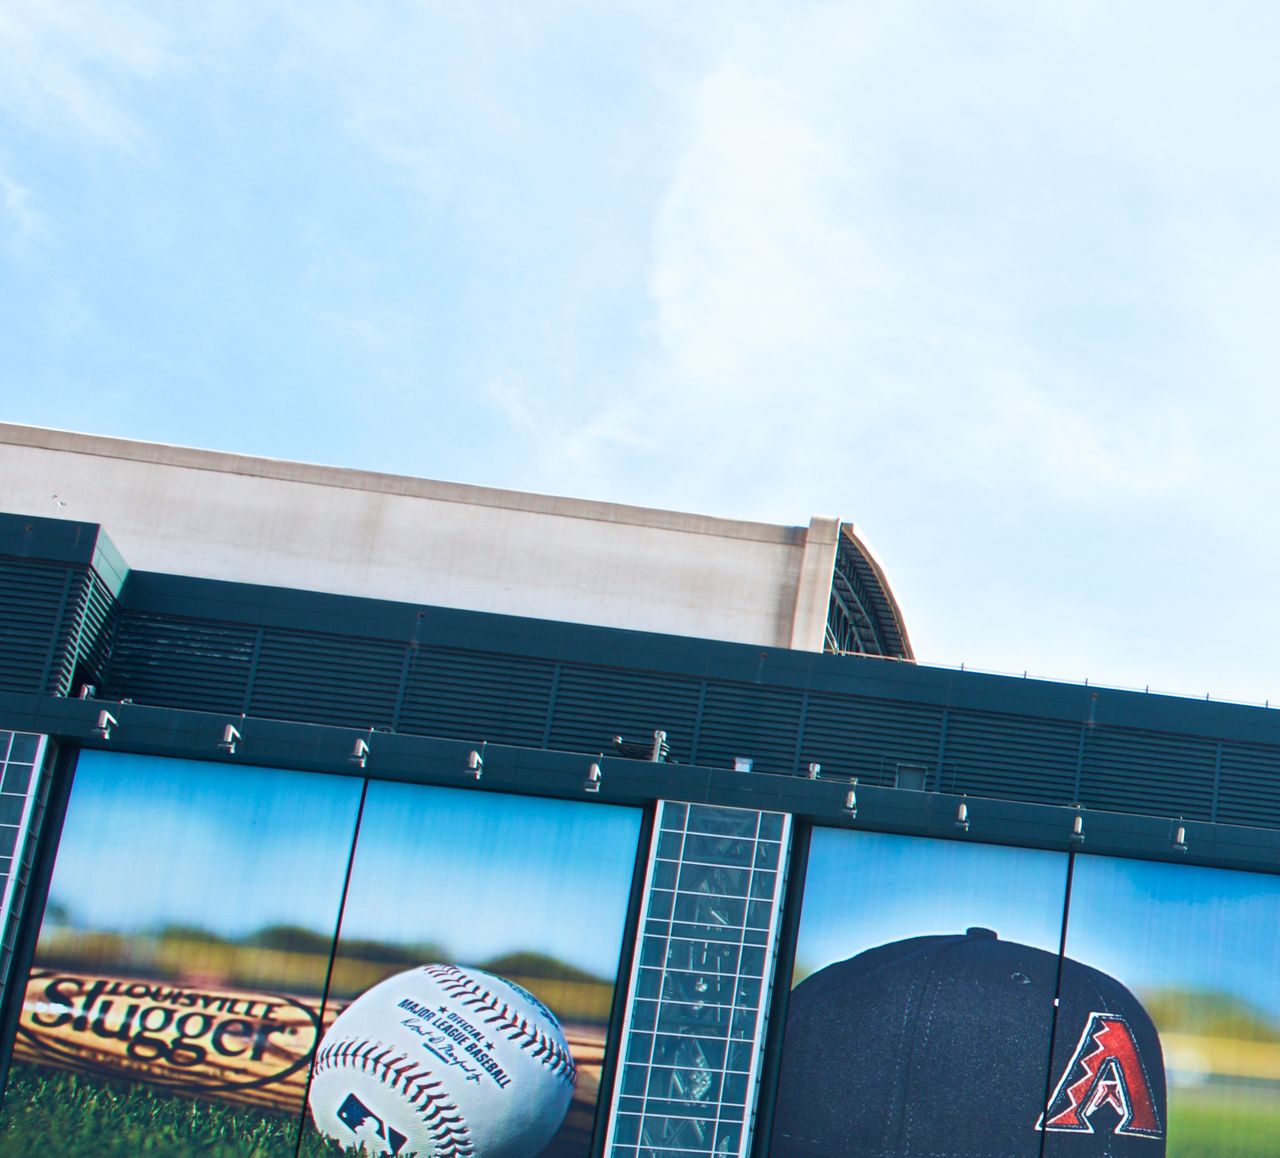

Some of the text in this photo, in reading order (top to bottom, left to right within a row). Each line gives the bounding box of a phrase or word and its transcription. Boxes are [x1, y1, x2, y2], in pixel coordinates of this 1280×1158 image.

[32, 978, 288, 1067] Slugger
[106, 981, 279, 1020] LOUISVILLE
[446, 1012, 485, 1043] OFFICIAL
[398, 999, 512, 1089] MAJOR LEAGUE BASEBALL
